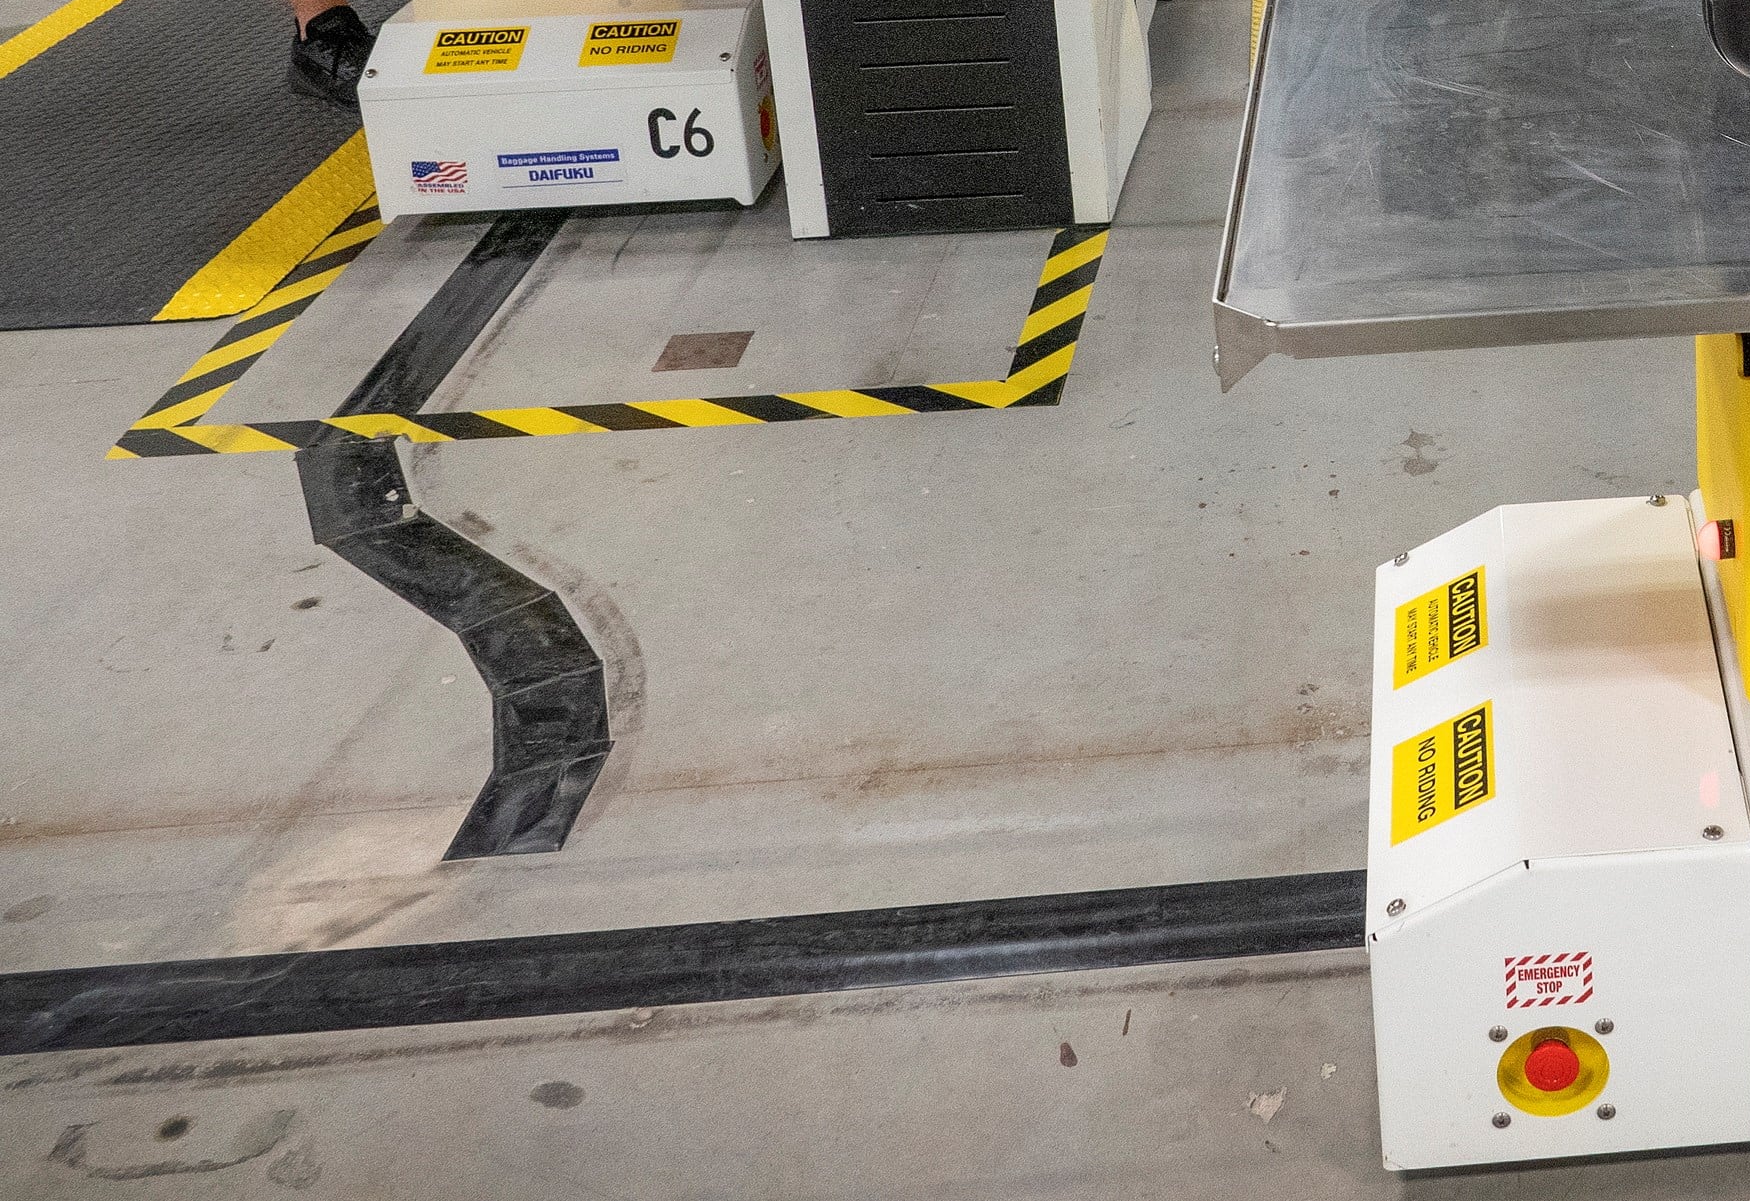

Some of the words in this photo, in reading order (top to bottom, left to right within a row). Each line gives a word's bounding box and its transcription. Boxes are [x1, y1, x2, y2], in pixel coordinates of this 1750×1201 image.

[441, 29, 522, 46] CAUTION
[594, 23, 675, 39] CAUTION
[441, 49, 481, 57] AUTOMATIC
[482, 48, 512, 56] VEHICLE
[590, 46, 613, 55] NO
[616, 44, 667, 54] RIDING
[452, 59, 474, 67] START
[491, 58, 508, 66] TIME
[647, 107, 715, 159] C6
[501, 156, 538, 166] Baggage
[539, 154, 577, 164] Handling
[579, 151, 616, 162] Systems
[528, 167, 594, 182] DAIFUKU
[1451, 578, 1477, 655] CAUTION
[1418, 736, 1436, 763] NO
[1457, 714, 1484, 805] CAUTION
[1418, 762, 1436, 823] RIDING
[1518, 964, 1580, 981] EMERGENCY
[1536, 980, 1563, 994] STOP
